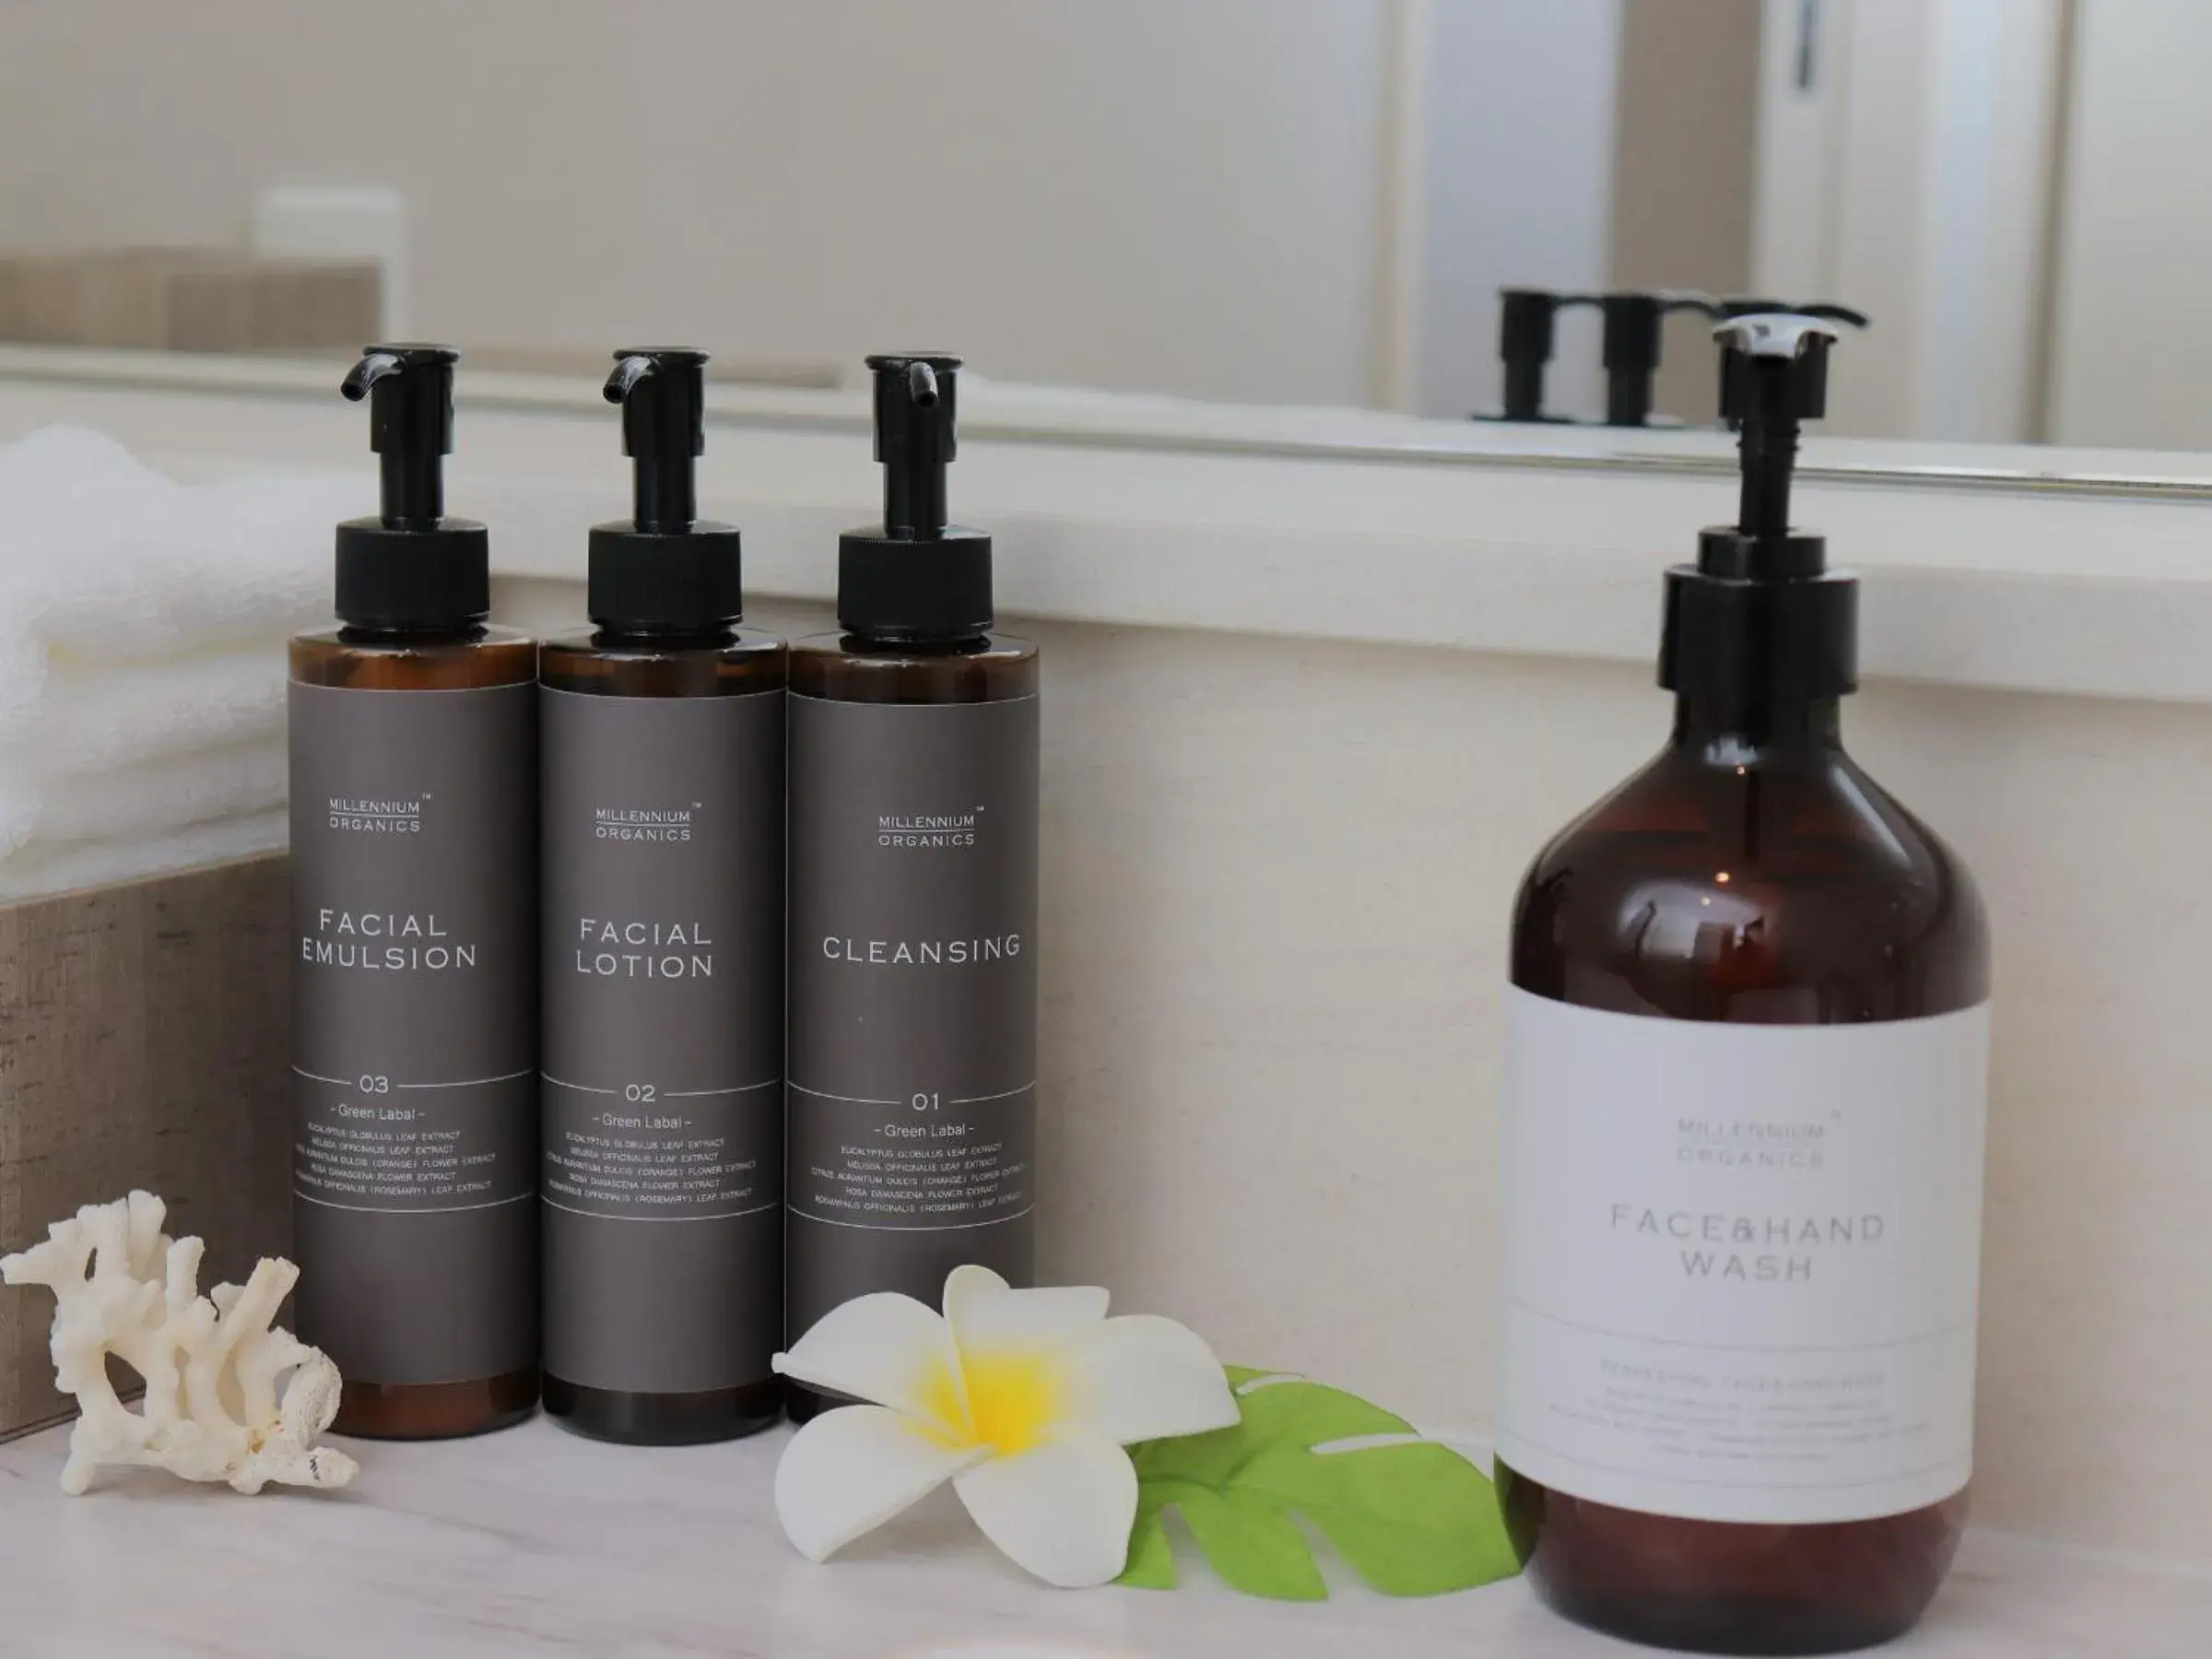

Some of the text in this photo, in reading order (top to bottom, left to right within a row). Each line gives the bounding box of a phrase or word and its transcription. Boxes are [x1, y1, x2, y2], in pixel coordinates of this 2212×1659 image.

[329, 798, 420, 813] MILLENNIUM
[595, 807, 689, 822] MILLENNIUM
[329, 818, 420, 832] ORGANICS
[878, 815, 974, 829] MILLENNIUM
[595, 827, 690, 841] ORGANICS
[877, 833, 974, 847] ORGANICS
[320, 908, 447, 936] FACIAL
[581, 918, 712, 945] FACIAL
[302, 936, 476, 970] EMULSION
[823, 934, 1019, 963] CLEANSING
[577, 949, 712, 978] LOTION
[359, 1075, 389, 1093] 03
[625, 1084, 656, 1102] 02
[912, 1092, 939, 1112] 01
[1610, 1202, 1885, 1244] FACE&HAND
[1680, 1249, 1813, 1282] WASH
